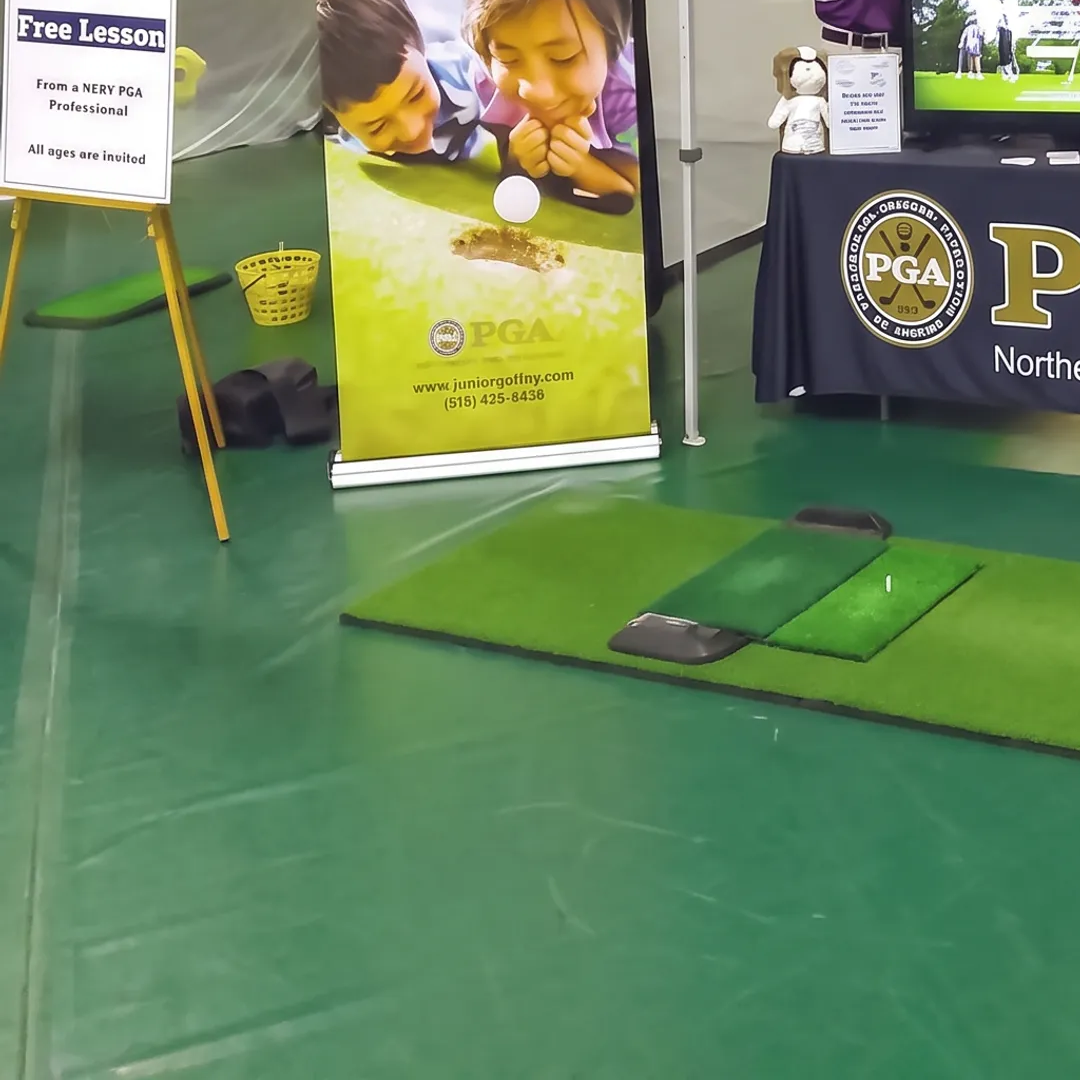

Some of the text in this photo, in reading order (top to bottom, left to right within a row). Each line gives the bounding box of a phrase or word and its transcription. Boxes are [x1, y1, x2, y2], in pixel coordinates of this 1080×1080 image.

[17, 13, 166, 49] Free Lesson
[36, 78, 143, 99] From a NERY PGA
[49, 99, 129, 117] Professional
[27, 143, 44, 156] All
[47, 145, 76, 161] ages
[79, 150, 100, 161] are
[865, 252, 950, 287] PGA
[470, 317, 556, 348] PGA
